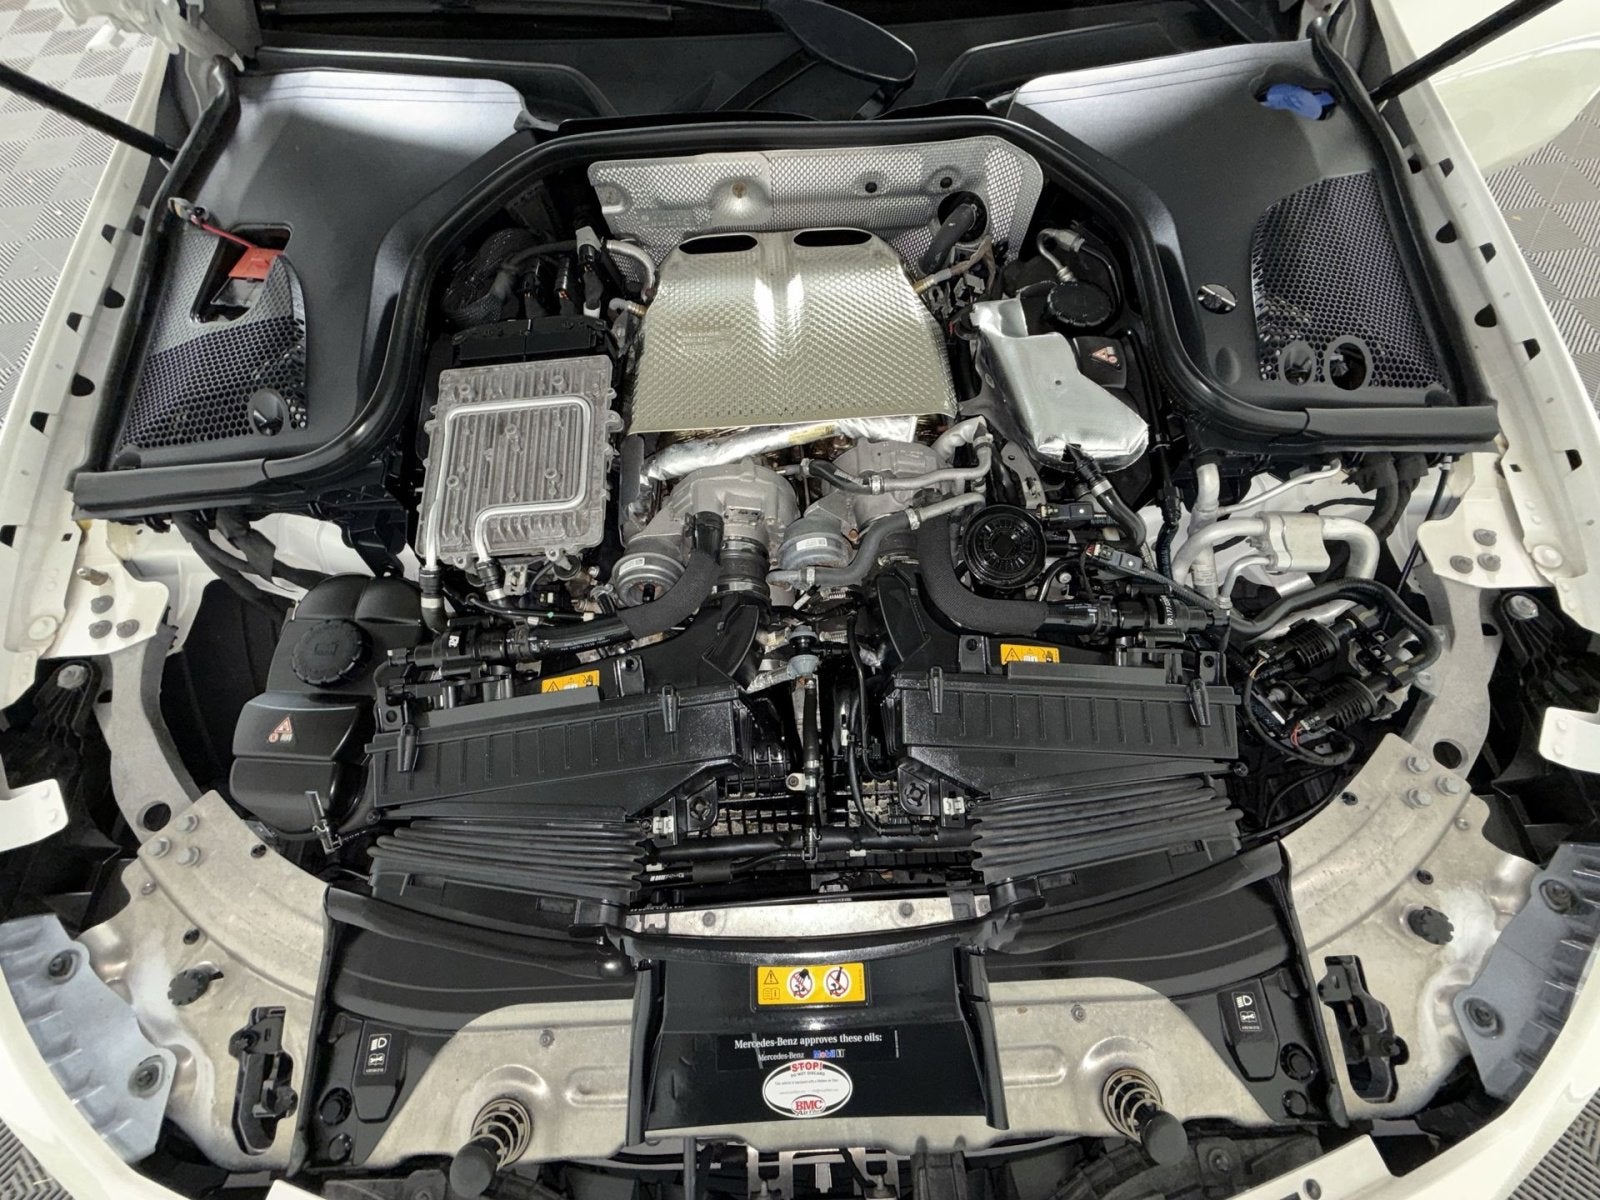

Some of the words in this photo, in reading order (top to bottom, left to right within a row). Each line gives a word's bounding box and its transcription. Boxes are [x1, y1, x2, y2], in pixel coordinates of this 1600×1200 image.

[734, 1037, 798, 1049] Mercedes-Benz
[799, 1035, 838, 1046] approves
[840, 1033, 863, 1043] these
[864, 1032, 883, 1042] oils:
[758, 1052, 804, 1062] Mercedes-Benz
[813, 1049, 836, 1059] Mobil
[791, 1061, 823, 1072] STOP!
[795, 1100, 823, 1110] BMC
